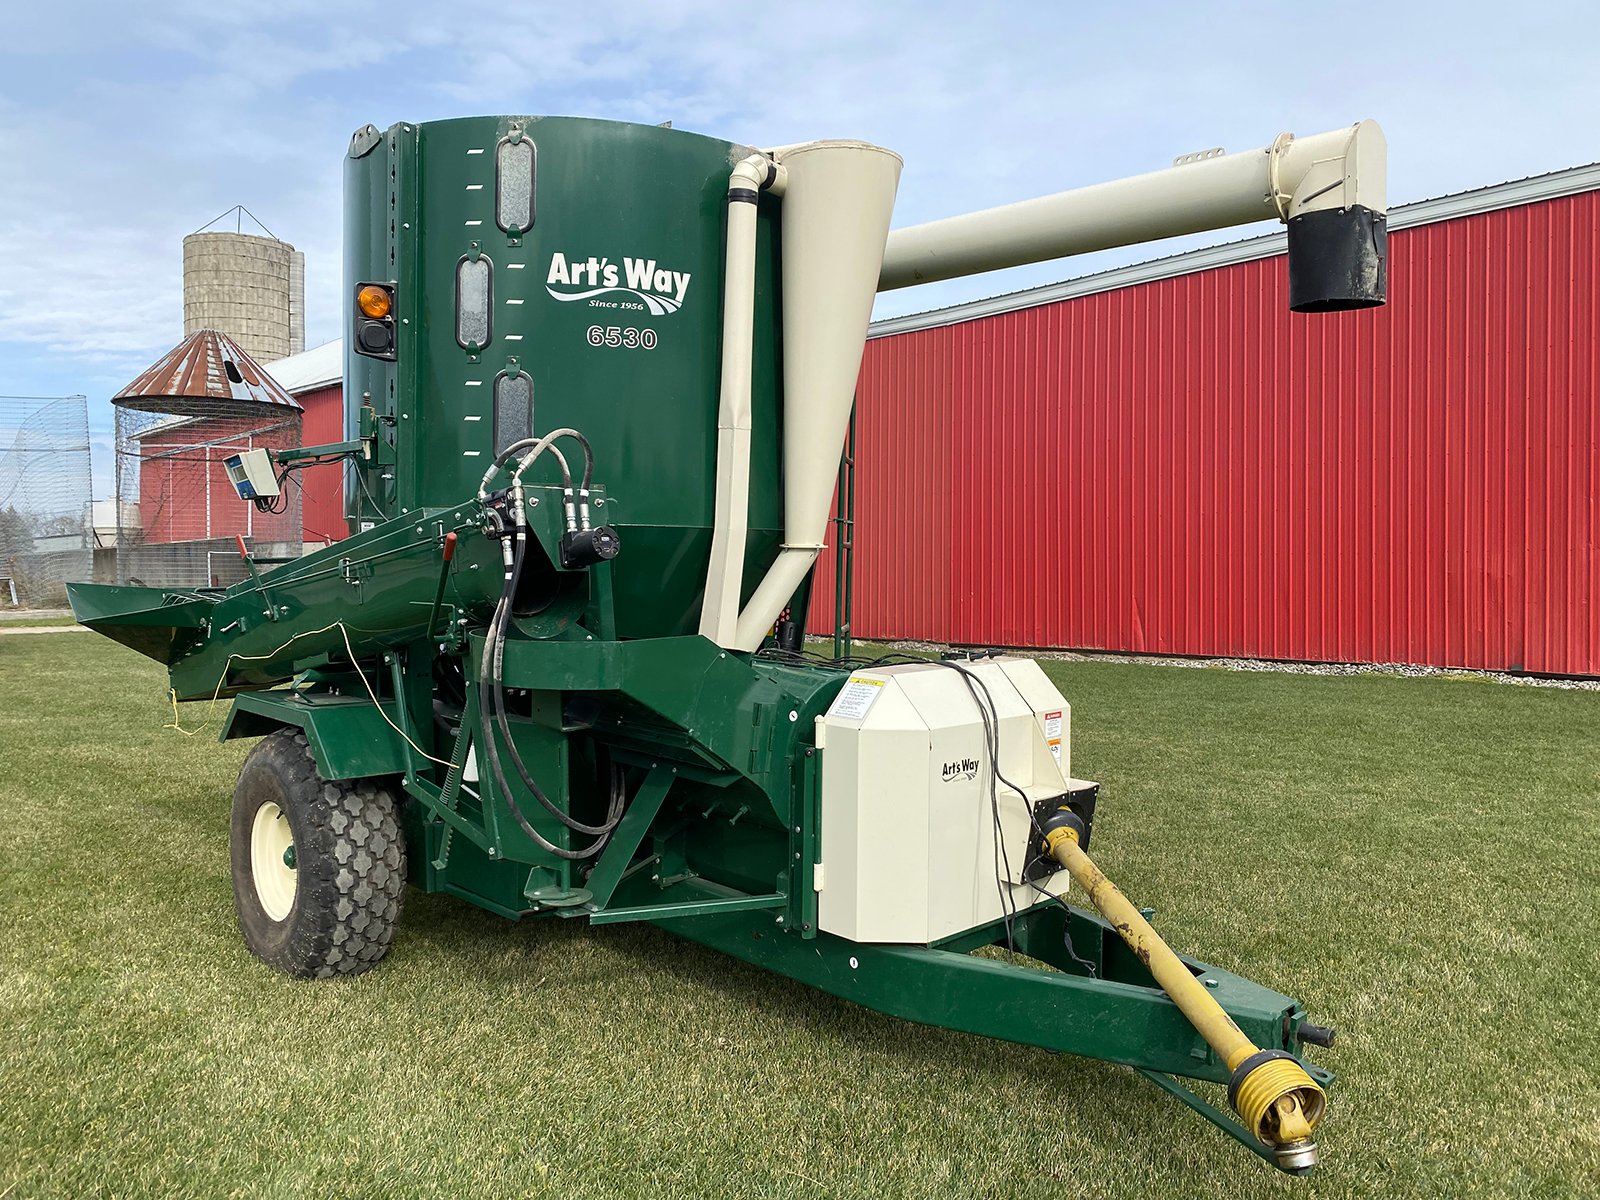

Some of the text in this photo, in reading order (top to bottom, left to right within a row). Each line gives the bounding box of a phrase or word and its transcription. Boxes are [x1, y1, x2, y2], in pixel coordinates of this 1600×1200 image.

[547, 252, 691, 303] Art's Way
[588, 300, 644, 311] Since 1956
[587, 325, 657, 349] 6530
[942, 759, 979, 776] Art's Way
